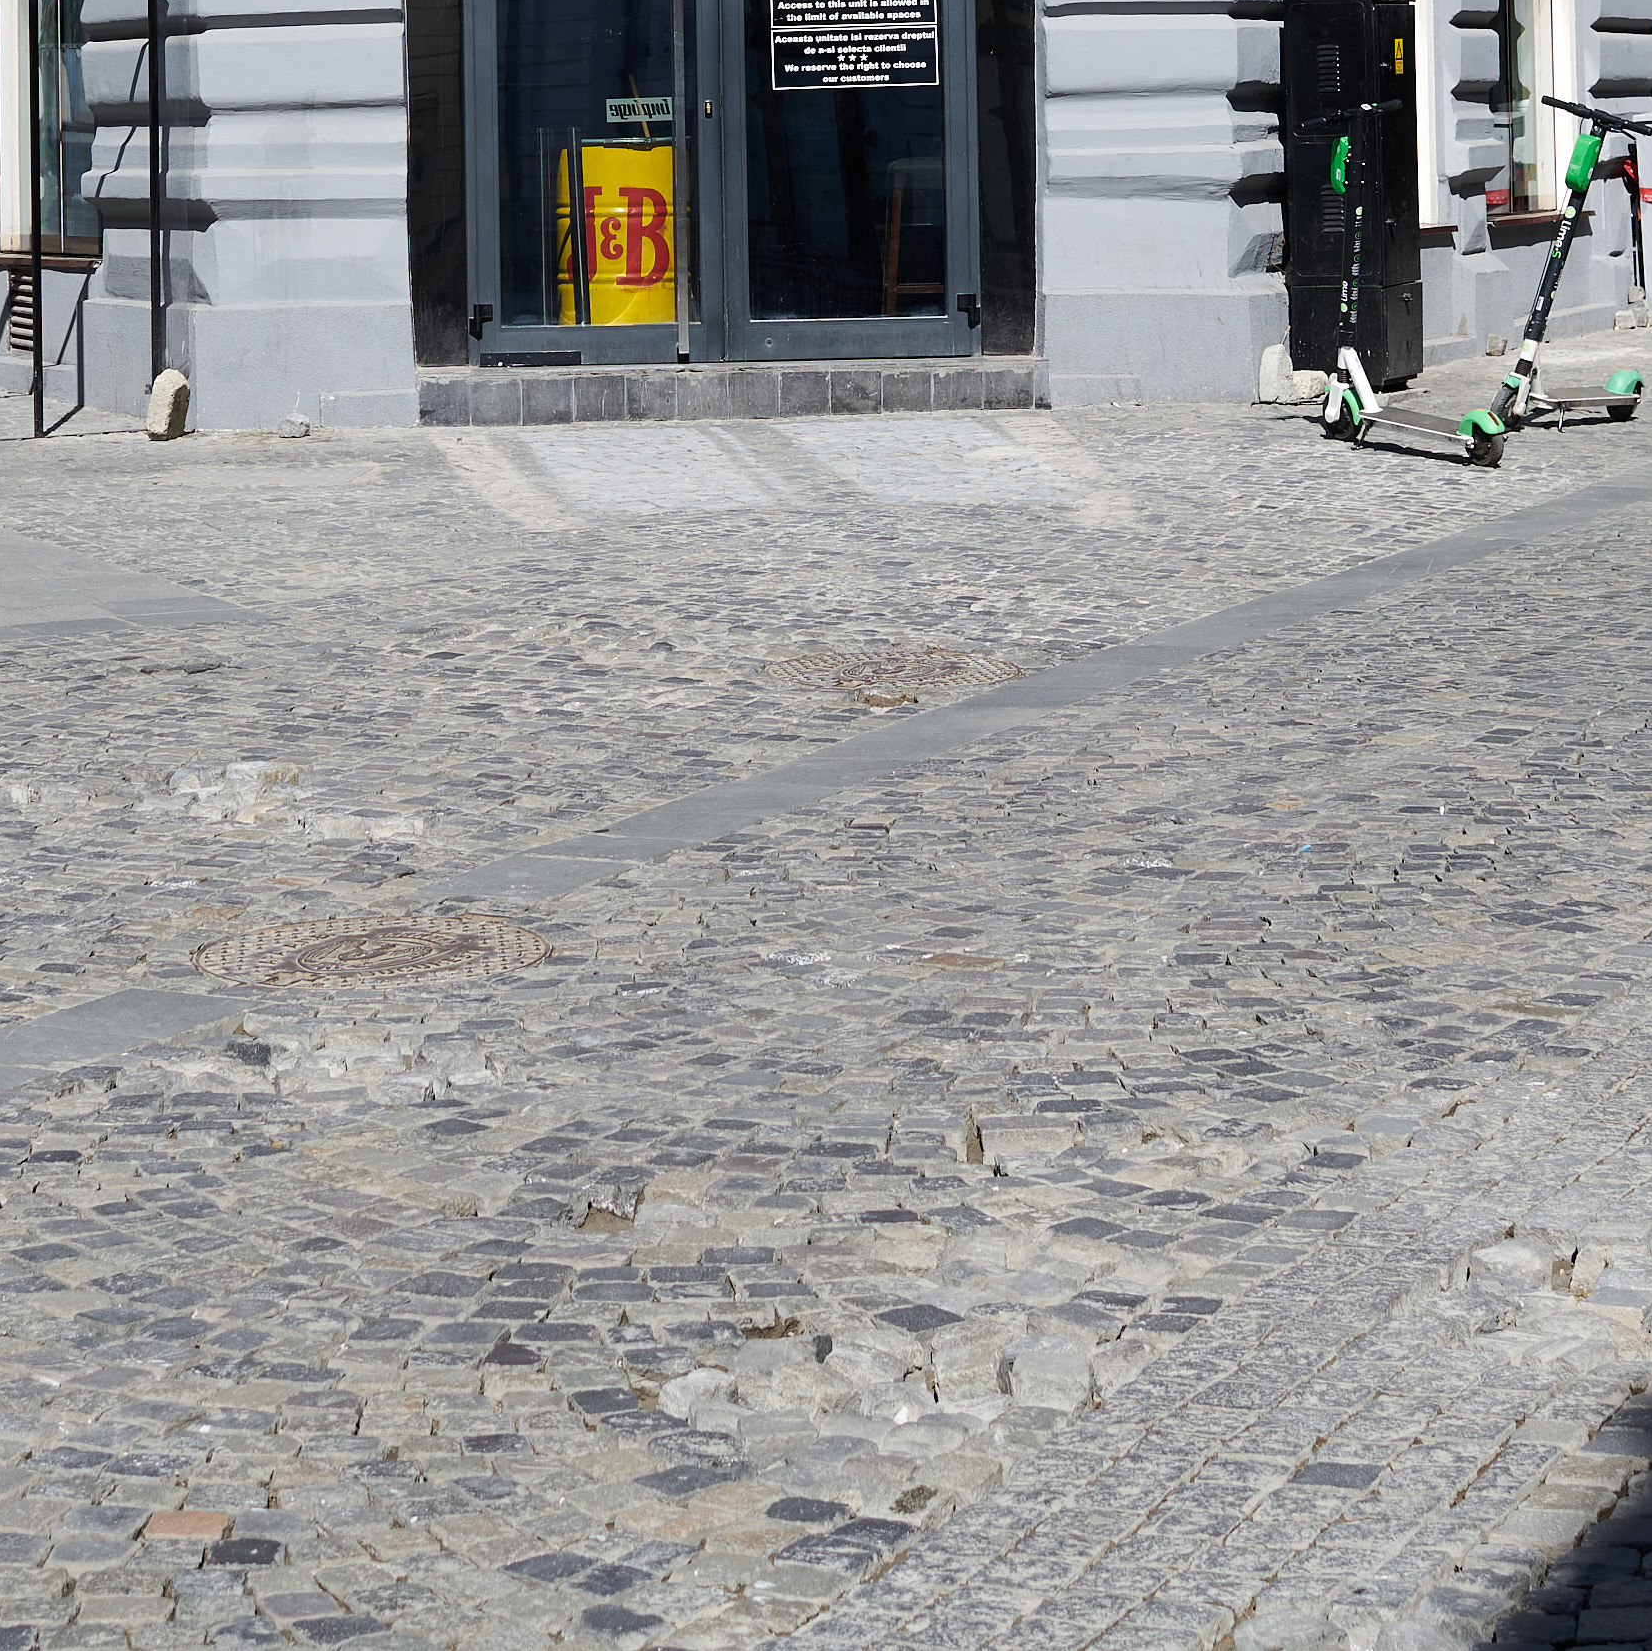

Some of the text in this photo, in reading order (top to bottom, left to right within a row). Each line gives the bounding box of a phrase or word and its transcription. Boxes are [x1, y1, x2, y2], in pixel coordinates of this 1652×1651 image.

[777, 1, 813, 10] Access
[815, 0, 825, 9] to
[827, 0, 846, 8] this
[848, 0, 868, 8] unit
[786, 11, 922, 22] the limit of available spaces
[774, 31, 935, 44] Aceasta unitate isi rezerva dreptul
[803, 43, 907, 55] de a-si selecta clientii
[784, 60, 927, 73] We reserve the right to choose
[822, 74, 890, 83] our customers
[566, 185, 670, 286] J&B
